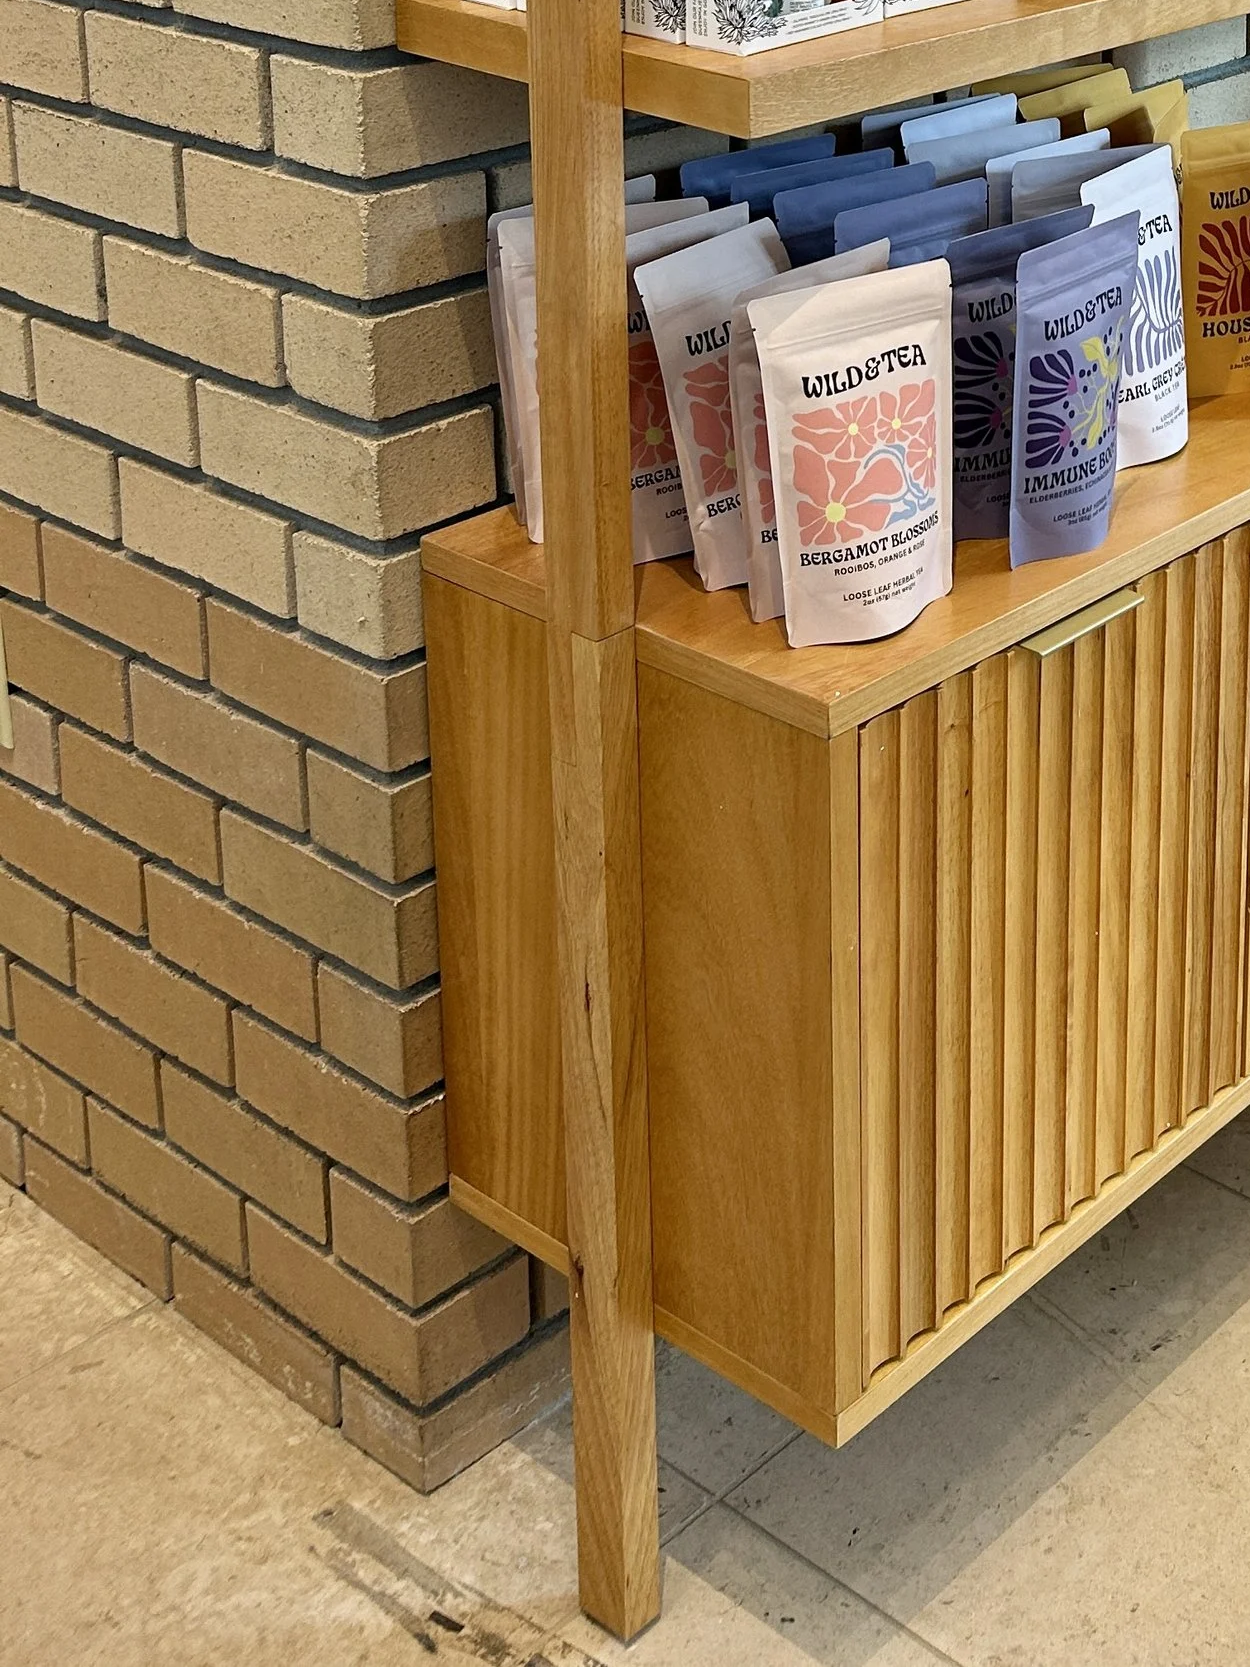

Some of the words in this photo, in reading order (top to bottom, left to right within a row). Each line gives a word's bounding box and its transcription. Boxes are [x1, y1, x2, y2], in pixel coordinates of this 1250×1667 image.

[1044, 286, 1122, 341] WILD&TEA
[801, 344, 927, 399] WILD&TEA
[1118, 381, 1151, 404] EARL
[1151, 369, 1173, 390] GREY
[1154, 387, 1172, 402] BLACK
[1023, 457, 1097, 494] IMMUNE
[1029, 486, 1084, 504] ELDERBERRIES,
[1053, 512, 1076, 522] LOOSE
[1078, 505, 1093, 517] LEAF
[800, 537, 889, 567] BERGAMOT
[891, 510, 939, 547] BLOSSOMS
[834, 560, 877, 576] ROOIBOS,
[878, 549, 907, 566] ORANGE
[913, 539, 925, 551] ROSE
[843, 588, 872, 602] LOOSE
[874, 582, 891, 596] LEAF
[892, 574, 916, 589] HERBAL
[916, 566, 924, 578] TEA
[862, 599, 875, 607] 2oz
